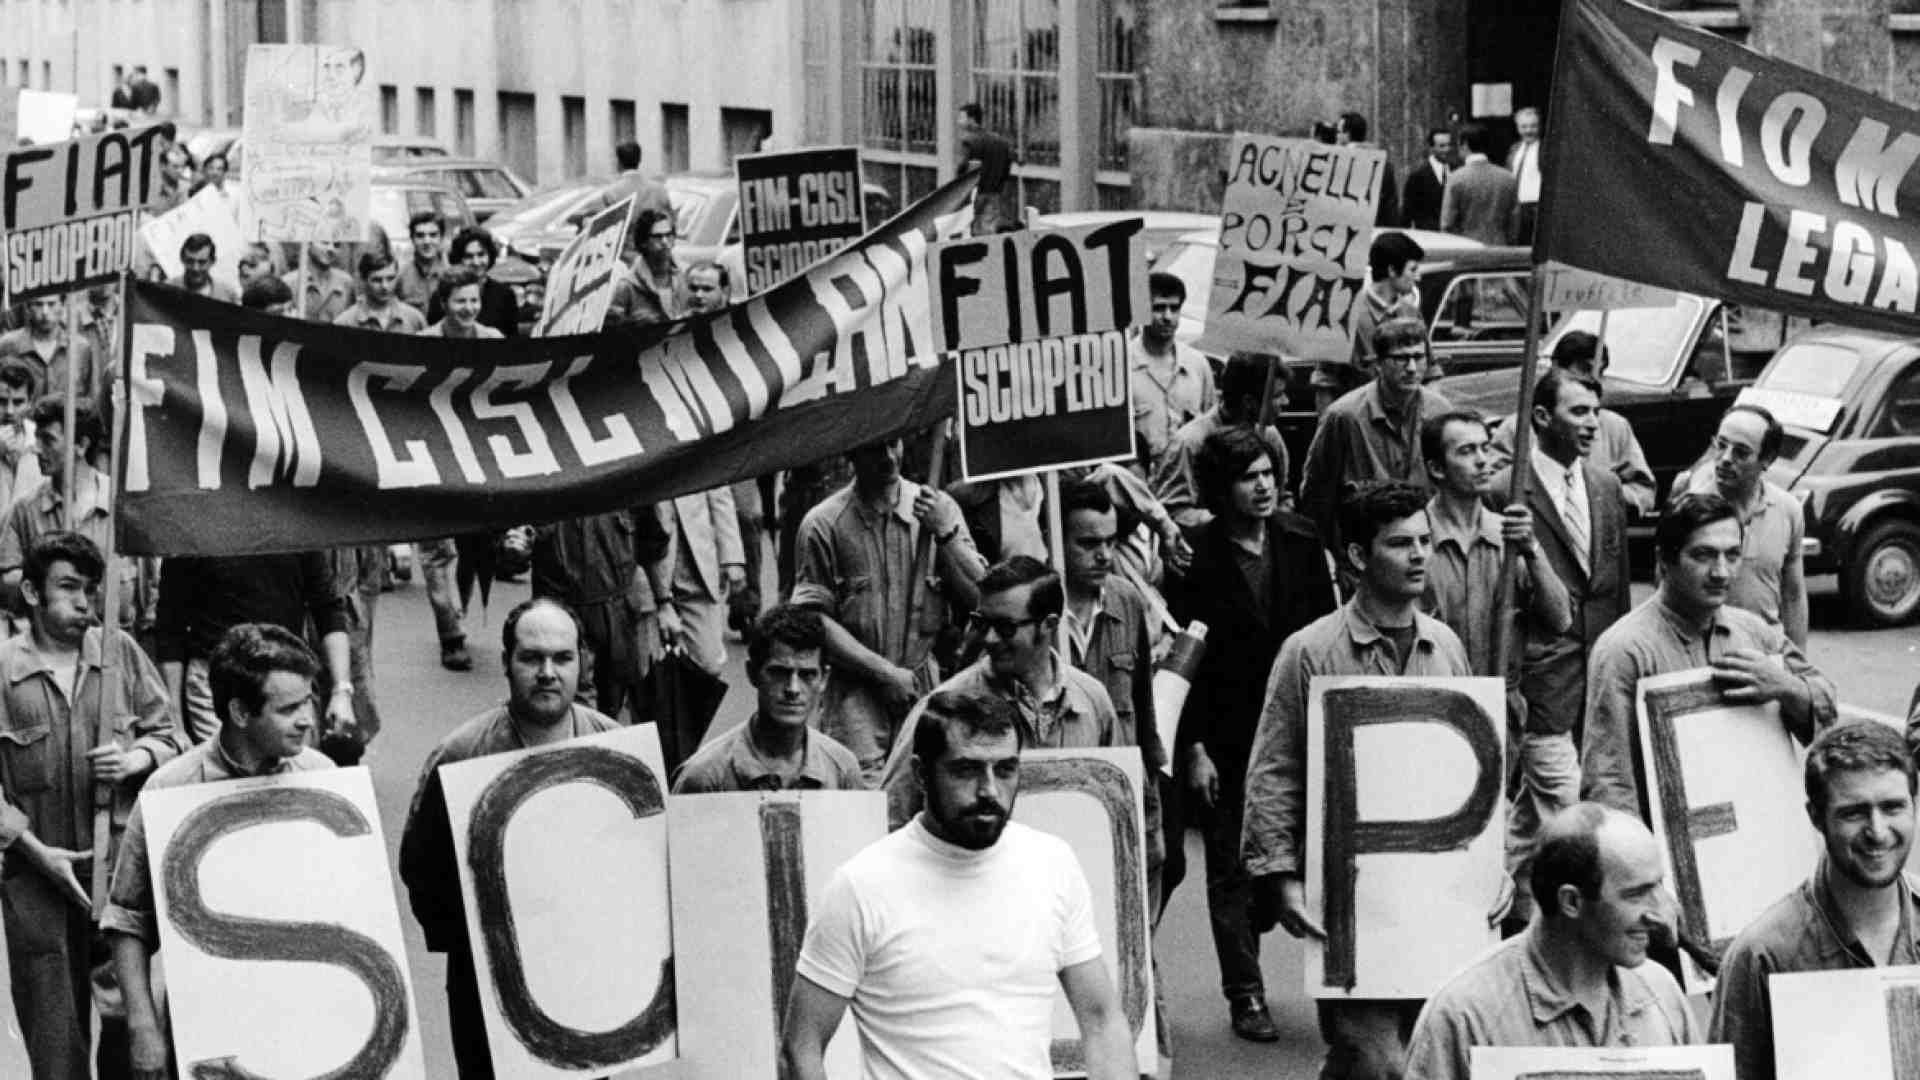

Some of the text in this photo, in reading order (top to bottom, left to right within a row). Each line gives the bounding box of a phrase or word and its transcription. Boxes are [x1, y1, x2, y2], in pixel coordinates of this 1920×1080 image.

[5, 122, 174, 229] FIAT
[1227, 143, 1379, 205] AGNELLI
[1648, 36, 1920, 218] FIOM
[10, 213, 131, 294] SCIOPERO
[742, 171, 860, 234] FIM-CISL
[1220, 212, 1358, 272] PORCI
[1727, 201, 1918, 313] LEGA
[940, 217, 1144, 351] FIAT
[1222, 260, 1364, 341] FIAT
[126, 323, 322, 491] FIM
[347, 354, 645, 489] CISL
[638, 187, 977, 442] MILAN
[964, 332, 1125, 426] SCIOPERO
[1322, 687, 1500, 993] P
[162, 787, 410, 1080] S
[467, 746, 679, 1070] C
